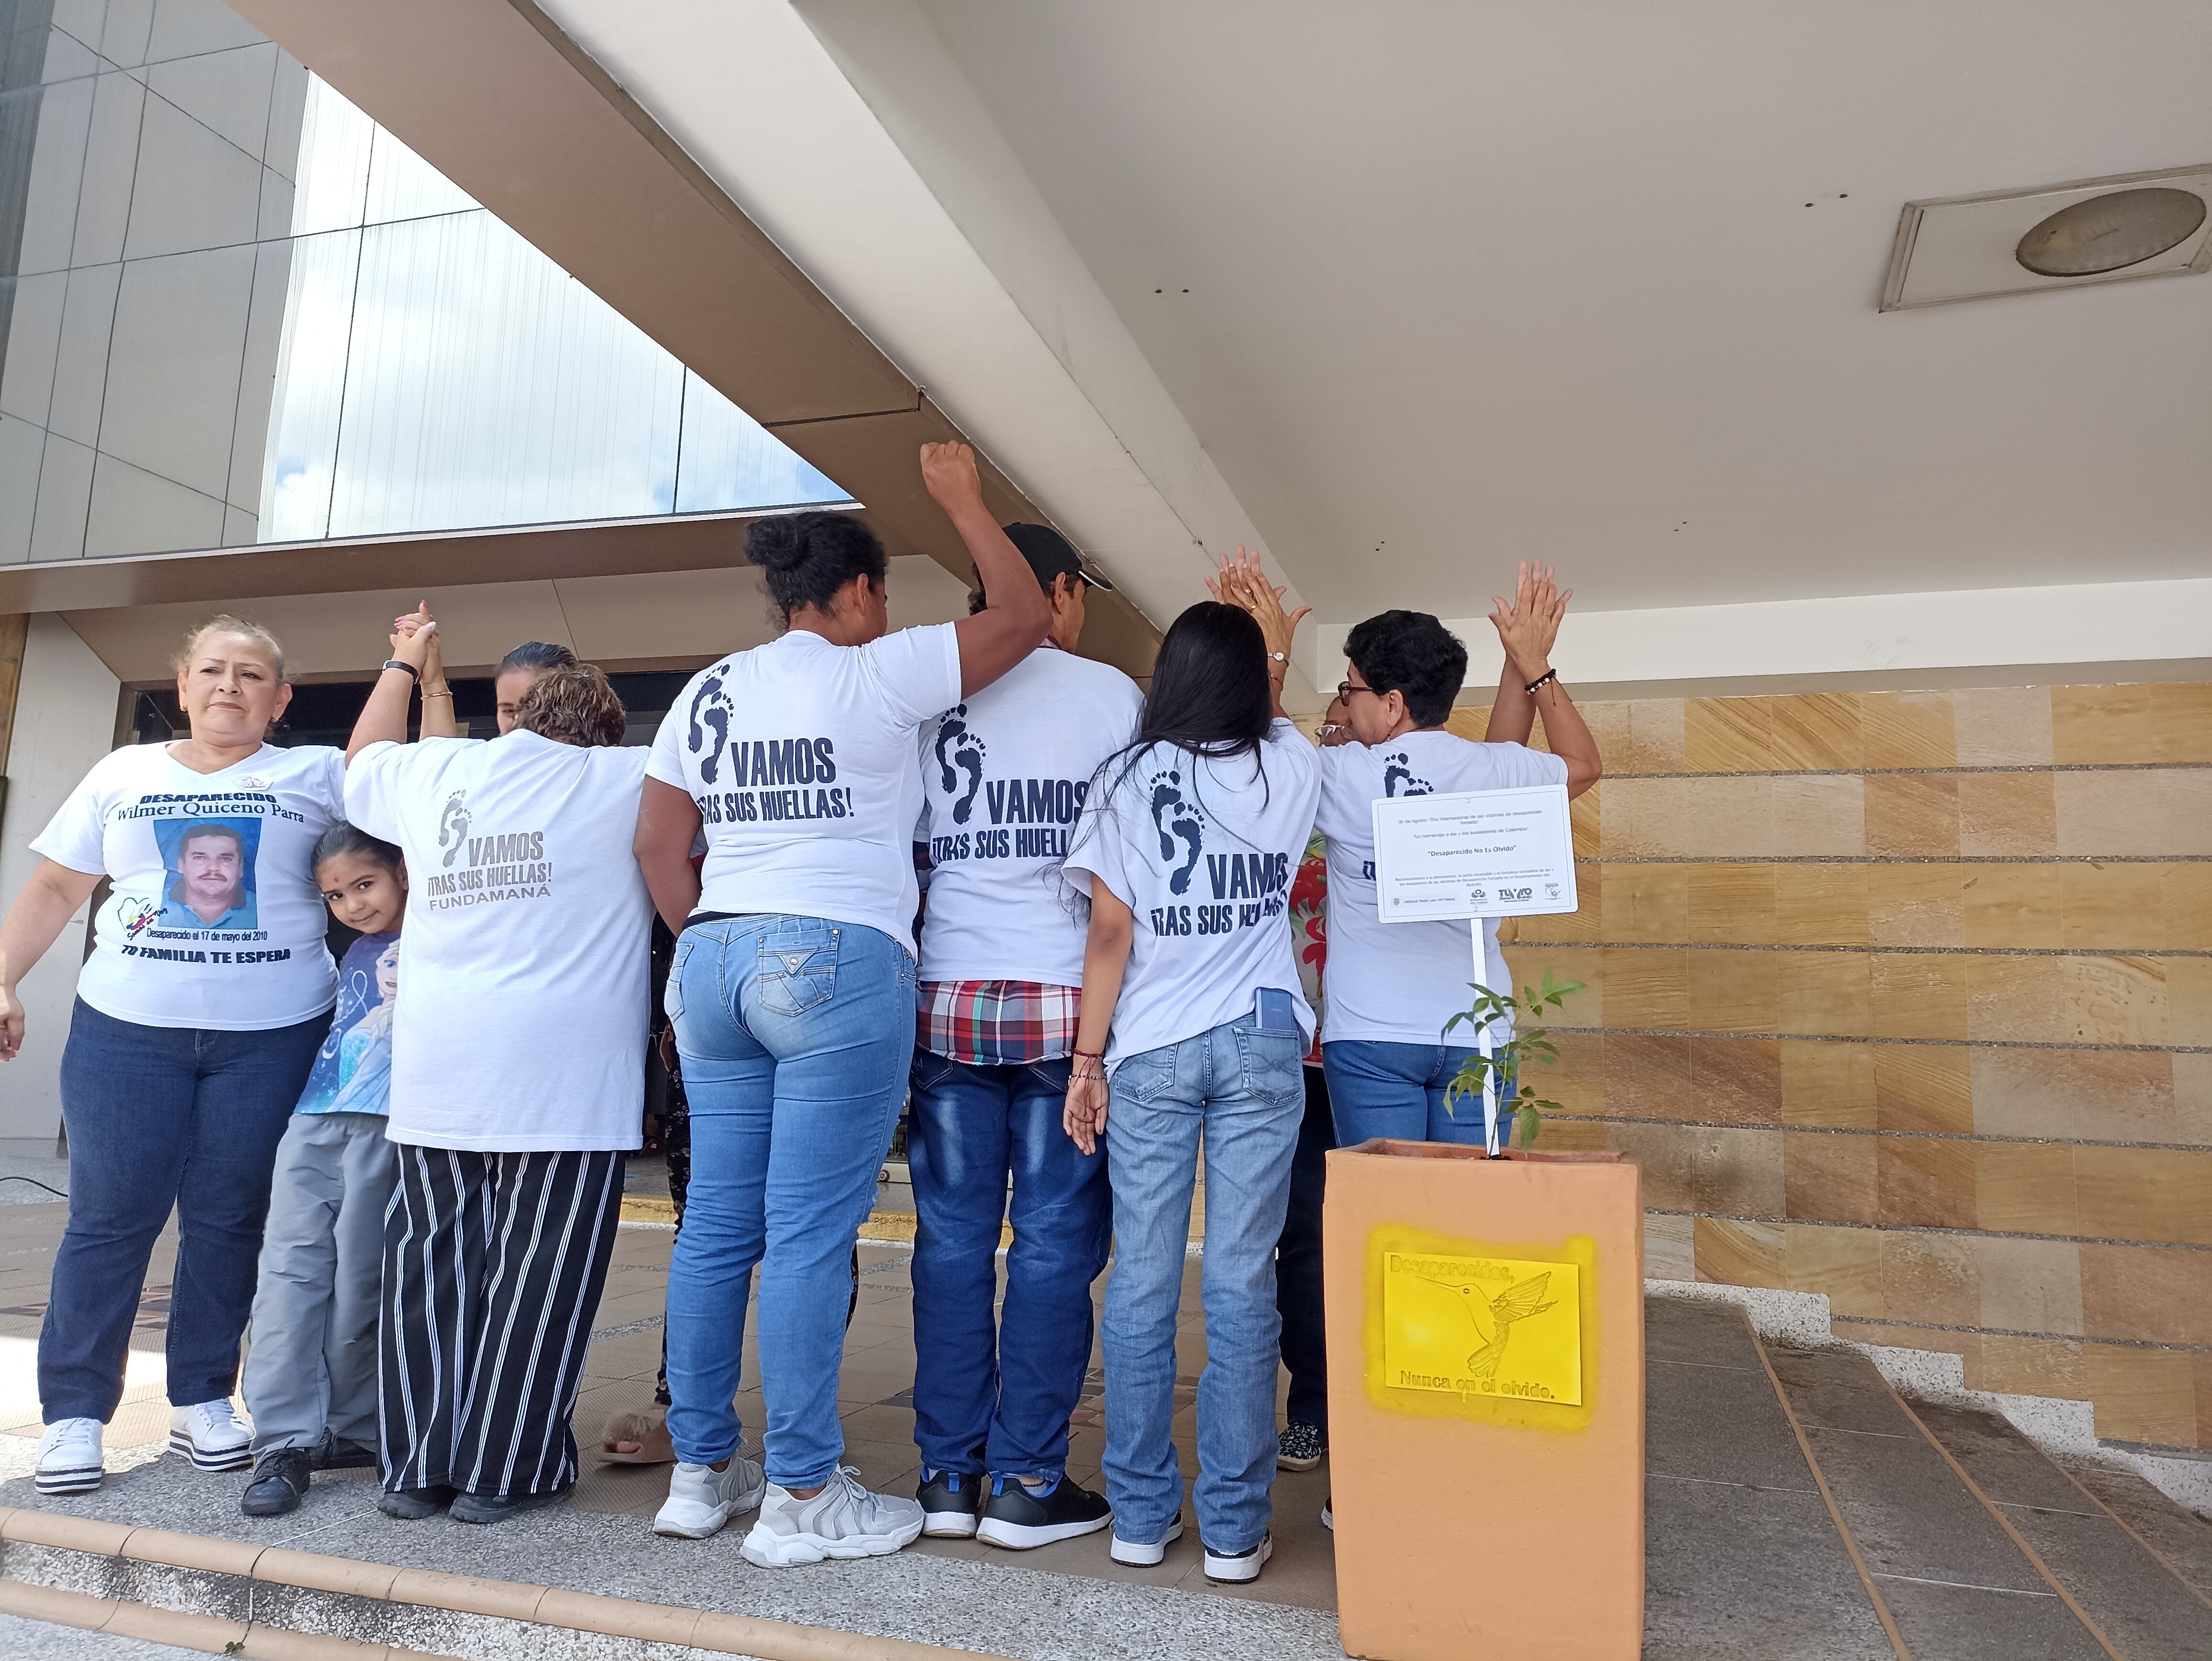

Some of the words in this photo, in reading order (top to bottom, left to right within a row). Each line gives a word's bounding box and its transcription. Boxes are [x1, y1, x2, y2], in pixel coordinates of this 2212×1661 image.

[731, 738, 836, 787] VAMOS
[118, 802, 176, 820] Wilmer
[183, 802, 265, 816] Quiceno
[272, 804, 304, 823] Parra
[139, 792, 277, 804] DESAPARECIDO
[725, 792, 757, 822] SUS
[760, 787, 854, 821] HUELLAS!
[468, 831, 543, 867] VAMOS
[975, 830, 1010, 859] SUS
[1427, 848, 1472, 856] "Desaparecido
[428, 873, 456, 897] ¡TRAS
[459, 869, 483, 891] SUS
[487, 863, 552, 887] HUELLAS!
[430, 884, 551, 910] FUNDAMANÁ
[1198, 905, 1233, 935] SUS
[147, 928, 191, 940] Desaparecido
[193, 931, 199, 940] el
[201, 931, 210, 940] 17
[211, 931, 220, 941] de
[221, 933, 240, 943] mayo
[242, 931, 251, 941] del
[253, 931, 268, 941] 2010
[140, 947, 206, 963] FAMILIA
[210, 952, 232, 963] TE
[236, 949, 291, 963] ESPERA
[1401, 1370, 1451, 1389] Nunca
[1481, 1379, 1495, 1393] el
[1501, 1380, 1555, 1399] olvido.
